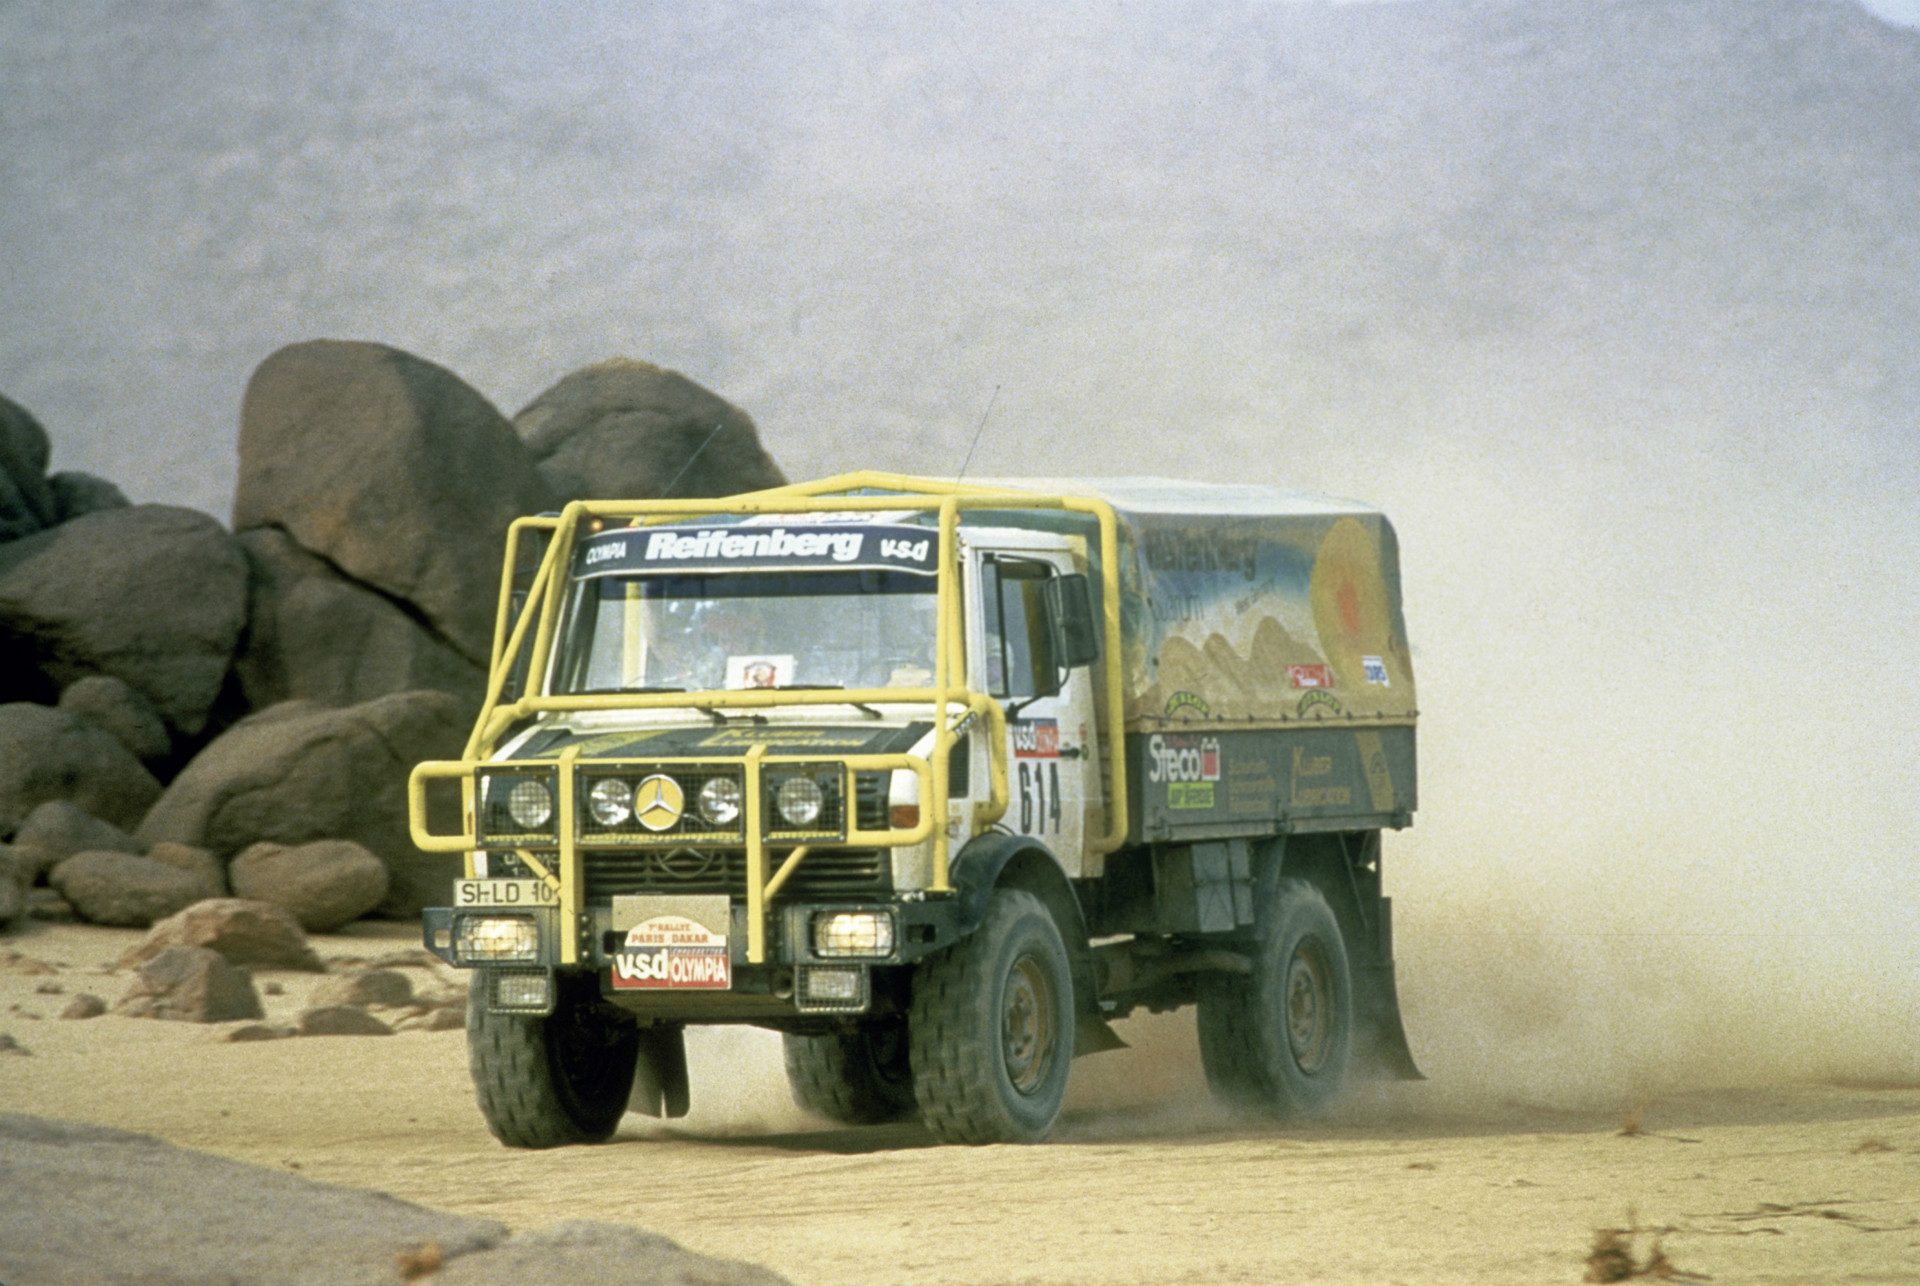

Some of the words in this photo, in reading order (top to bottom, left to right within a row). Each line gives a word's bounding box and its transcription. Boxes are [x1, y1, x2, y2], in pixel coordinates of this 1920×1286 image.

[586, 541, 627, 565] OLYMPIA
[645, 530, 863, 561] Reifenberg
[1149, 733, 1201, 783] Steco
[1018, 761, 1062, 835] 614
[631, 933, 665, 944] PARIS
[671, 933, 709, 944] DAKAR
[658, 923, 691, 932] RALLYE
[616, 947, 669, 981] vsd
[670, 956, 727, 983] OLYMPIA
